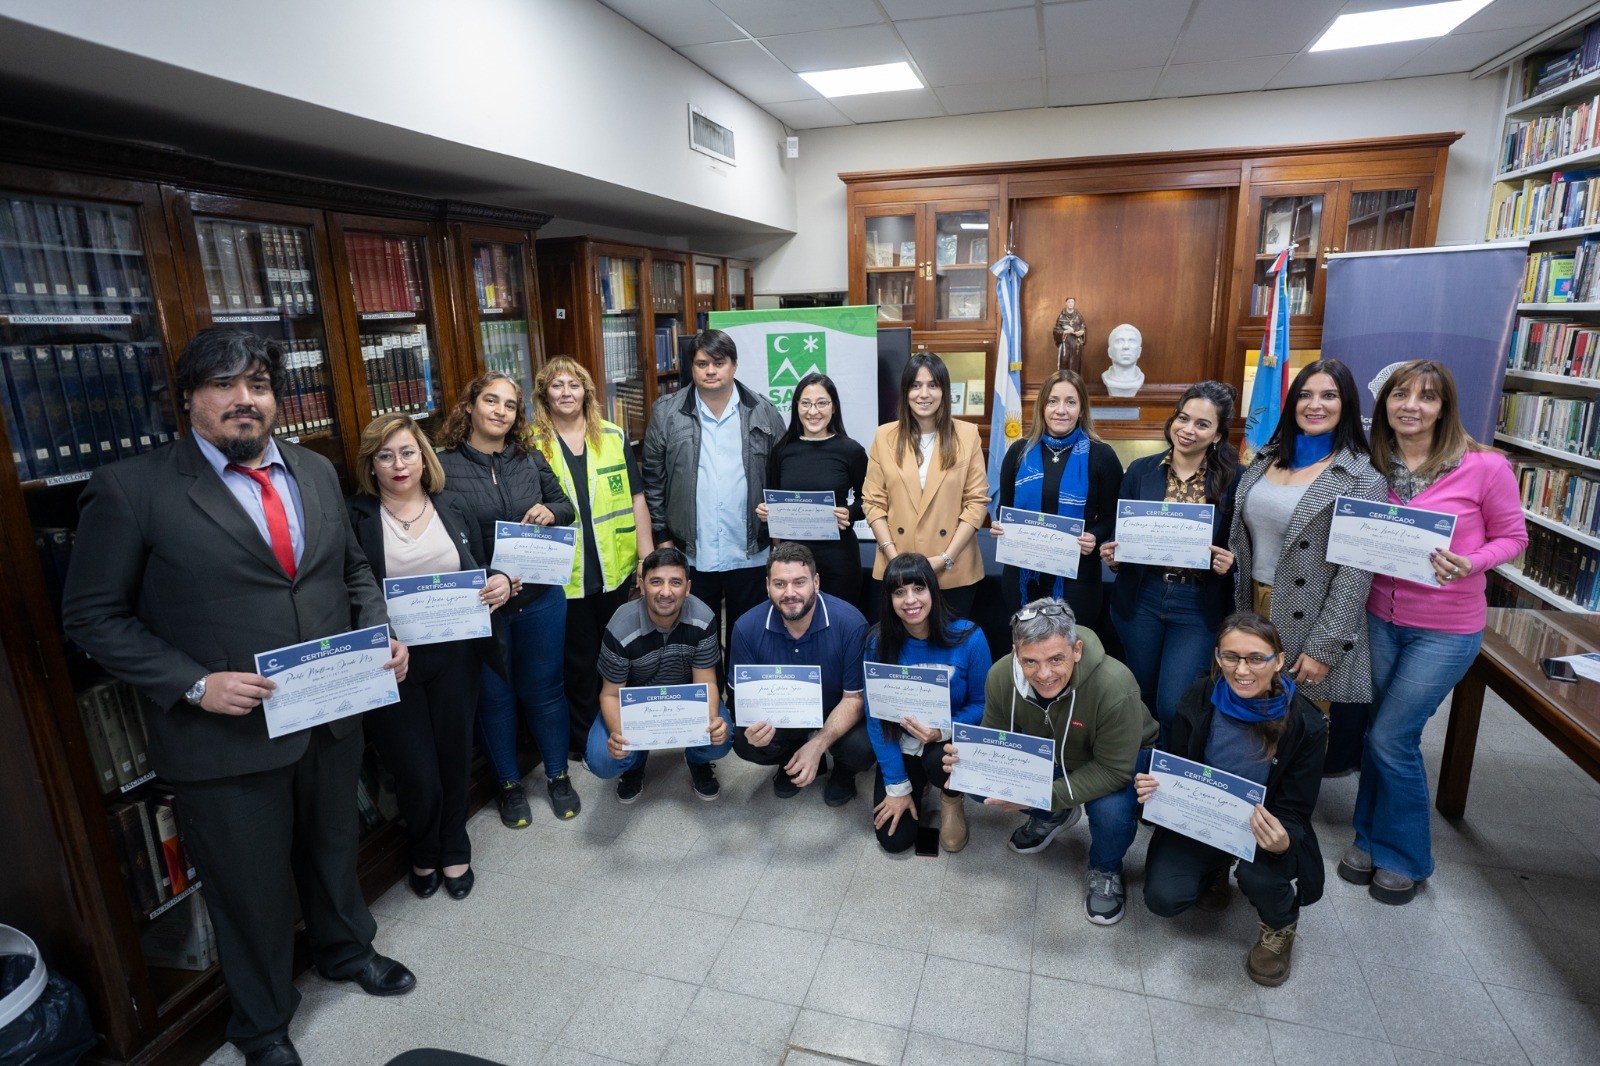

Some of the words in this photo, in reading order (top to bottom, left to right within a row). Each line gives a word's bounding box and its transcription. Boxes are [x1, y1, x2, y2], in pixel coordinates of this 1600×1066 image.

[769, 388, 793, 405] SA
[1361, 414, 1373, 424] ice
[1024, 518, 1058, 529] CERTIFICADO
[1368, 511, 1416, 525] CERTIFICADO
[520, 531, 552, 539] CERTIFICADO
[417, 581, 457, 592] CERTIFICADO
[300, 644, 352, 663] CERTIFICADO
[888, 673, 923, 681] CERTIFICADO
[646, 693, 682, 701] CERTIFICADO
[982, 737, 1022, 749] CERTIFICADO
[1184, 770, 1229, 790] CERTIFICADO
